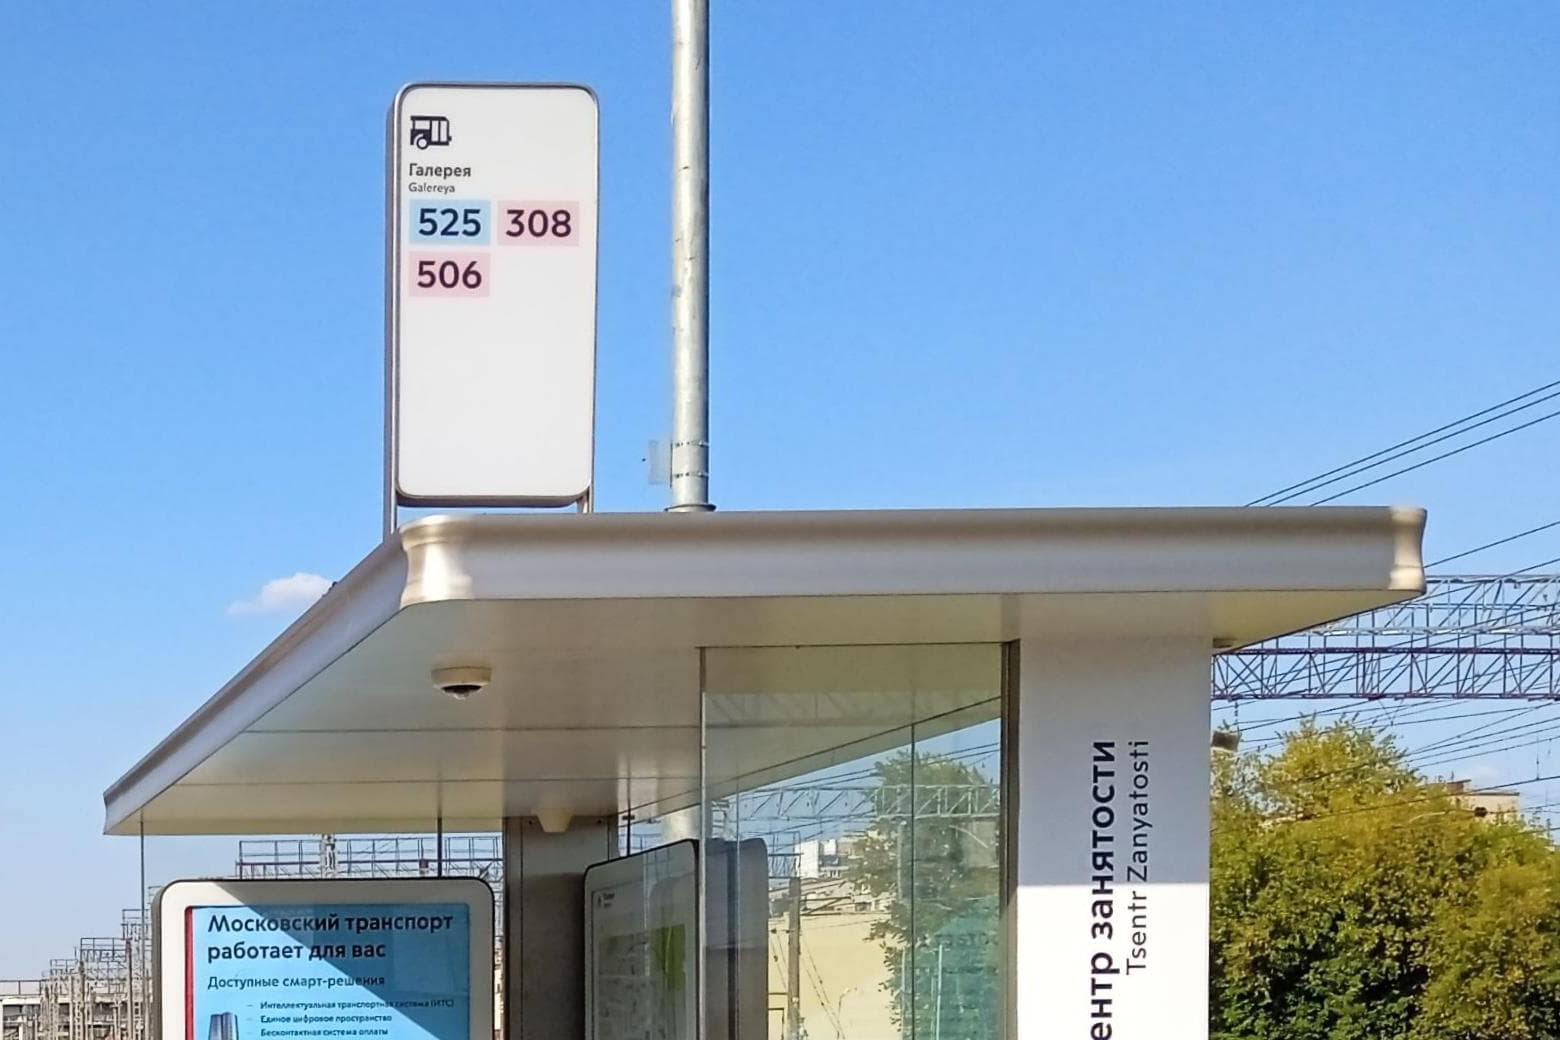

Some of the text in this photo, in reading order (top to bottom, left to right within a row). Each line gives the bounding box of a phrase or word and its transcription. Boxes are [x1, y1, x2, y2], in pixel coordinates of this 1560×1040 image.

[409, 163, 472, 180] Галерея
[408, 182, 456, 195] Galereya
[418, 207, 572, 238] 525 308
[417, 260, 482, 289] 506
[1090, 741, 1116, 940] занятости
[1126, 740, 1153, 976] Tsentr Zanyatosti
[207, 913, 454, 934] Московский транспорт
[207, 941, 386, 964] работает для вас
[207, 976, 386, 990] Доступные смарт-решения
[260, 1001, 336, 1011] Интеллектуальная
[260, 1014, 393, 1024] Единое цифровое пространство
